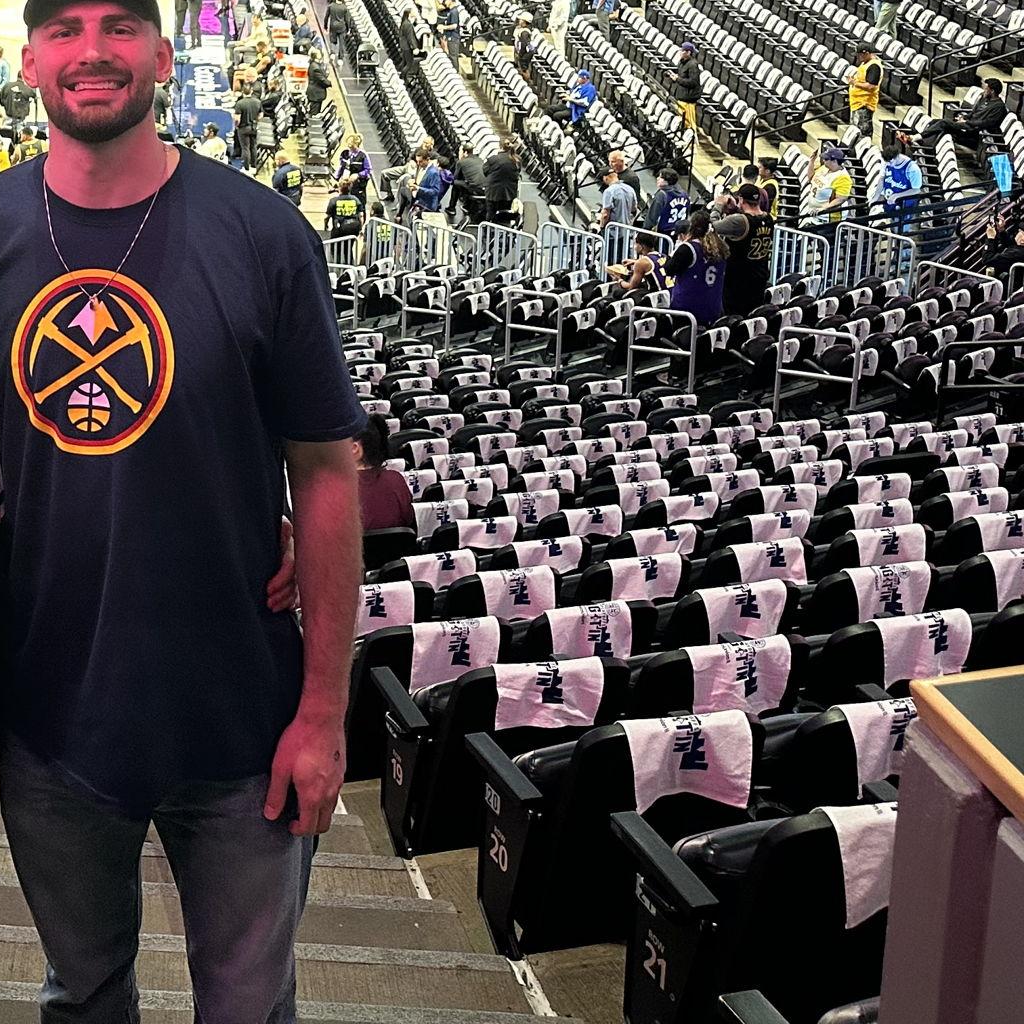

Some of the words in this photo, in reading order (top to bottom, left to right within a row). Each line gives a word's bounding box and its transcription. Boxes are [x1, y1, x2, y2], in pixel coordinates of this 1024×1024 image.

[668, 206, 687, 224] 34
[705, 265, 717, 285] 6
[391, 758, 403, 786] 19
[486, 785, 498, 813] 20
[489, 832, 508, 872] 20
[647, 928, 665, 954] ROW
[643, 939, 667, 991] 21
